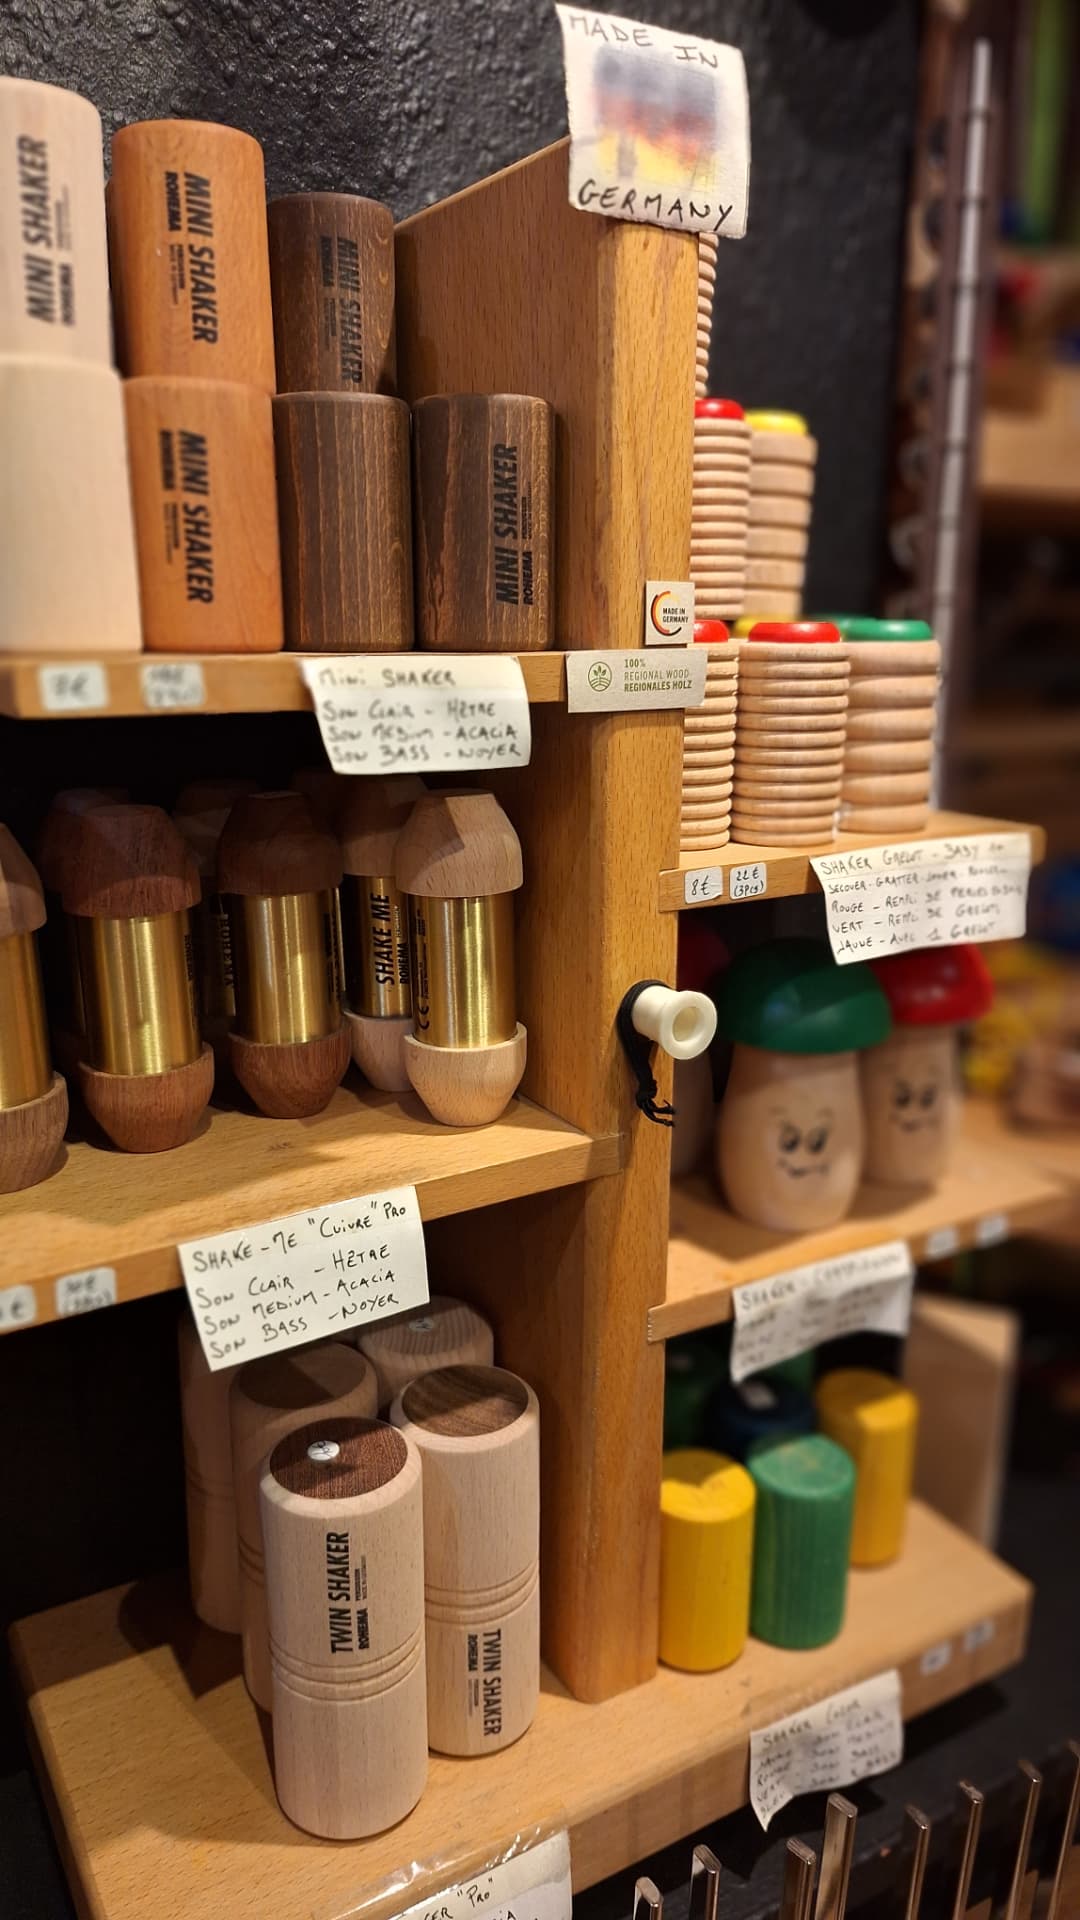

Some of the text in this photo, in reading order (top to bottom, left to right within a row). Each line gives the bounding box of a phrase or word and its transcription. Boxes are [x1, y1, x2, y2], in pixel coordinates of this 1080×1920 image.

[569, 16, 718, 68] MADE IN
[577, 179, 733, 231] GERMANY
[17, 134, 56, 325] MINI SHAKER
[184, 171, 219, 344] MINI SHAKER
[336, 236, 363, 384] MINI SHAKER
[179, 430, 214, 604] MINI SHAKER
[493, 443, 519, 605] MINI SHAKER
[522, 551, 534, 605] ROHEMA
[662, 607, 686, 615] MADE IN
[662, 616, 689, 624] GERMANY
[381, 667, 456, 688] SHAKER
[624, 659, 646, 668] 100%
[624, 669, 690, 681] REGIONAL WOOD
[624, 680, 692, 692] REGIONALES HOLZ
[456, 722, 518, 741] ACACIA
[457, 743, 522, 761] NOYER
[820, 855, 873, 876] SHAKER
[831, 900, 864, 913] ROUGE
[832, 920, 864, 934] VERT
[370, 893, 396, 986] SHAKE ME
[837, 936, 873, 955] JAUNE
[397, 943, 410, 985] ROHEMA
[195, 1287, 235, 1310] SON
[247, 1275, 295, 1297] CLAIR
[203, 1314, 241, 1336] SON
[336, 1267, 396, 1297] ACACIA
[209, 1337, 247, 1360] SON
[261, 1316, 308, 1343] BASS
[341, 1293, 400, 1319] NOYER
[326, 1532, 354, 1654] TWIN SHAKER
[357, 1607, 370, 1650] ROHEMA
[483, 1628, 502, 1736] TWIN SHAKER
